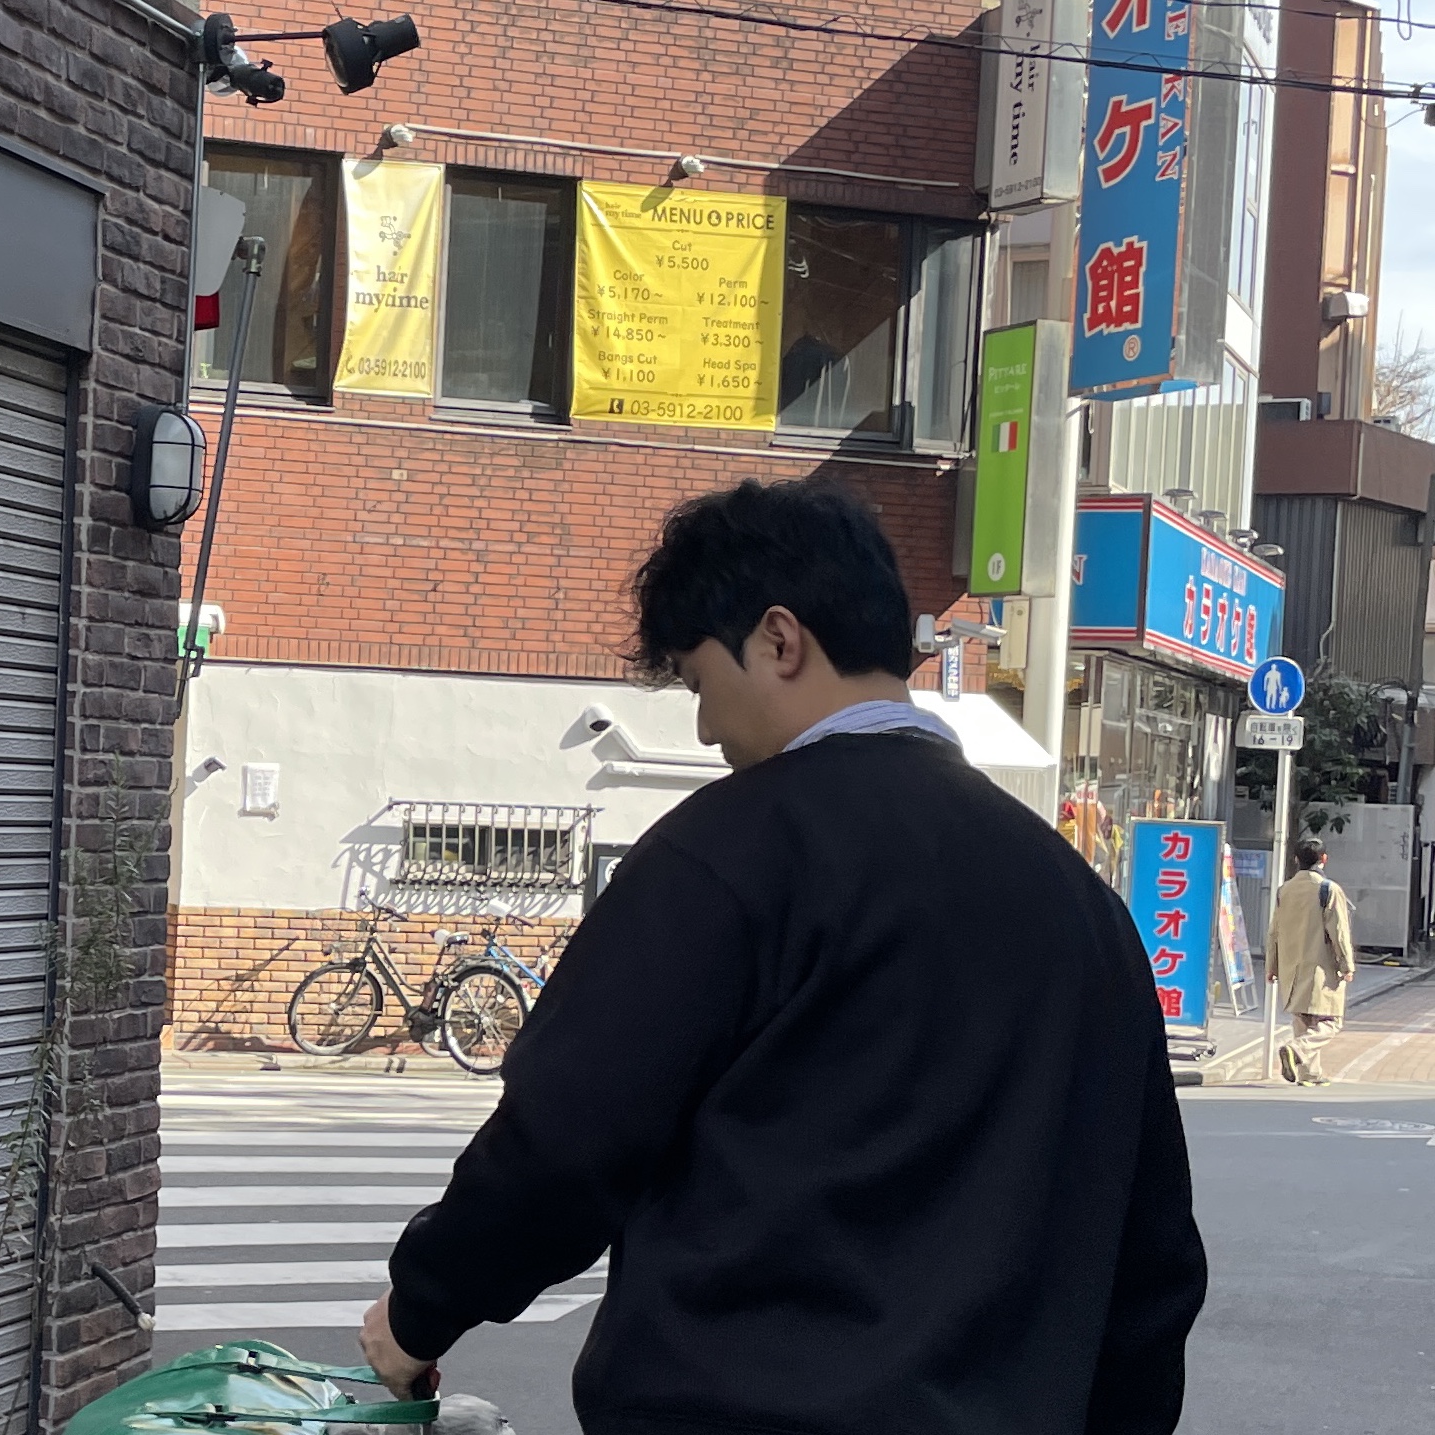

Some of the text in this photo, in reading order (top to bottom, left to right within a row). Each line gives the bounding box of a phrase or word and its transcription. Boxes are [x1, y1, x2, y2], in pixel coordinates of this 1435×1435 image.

[1009, 101, 1026, 166] time
[1155, 66, 1185, 182] KAN
[651, 206, 775, 231] MENU PRICE
[671, 240, 693, 252] Cut
[376, 265, 408, 284] hair
[613, 269, 645, 282] Color
[718, 277, 748, 290] Perm
[587, 308, 669, 325] Straight Perm
[702, 316, 761, 331] Treatment
[598, 350, 658, 366] Bangs Cut
[702, 358, 757, 373] Head Spa
[358, 358, 427, 380] 03-5912-2100
[630, 399, 744, 421] 03-5912-2100
[1182, 574, 1257, 665] カラオケ館
[1152, 831, 1193, 1019] カラオケ館
